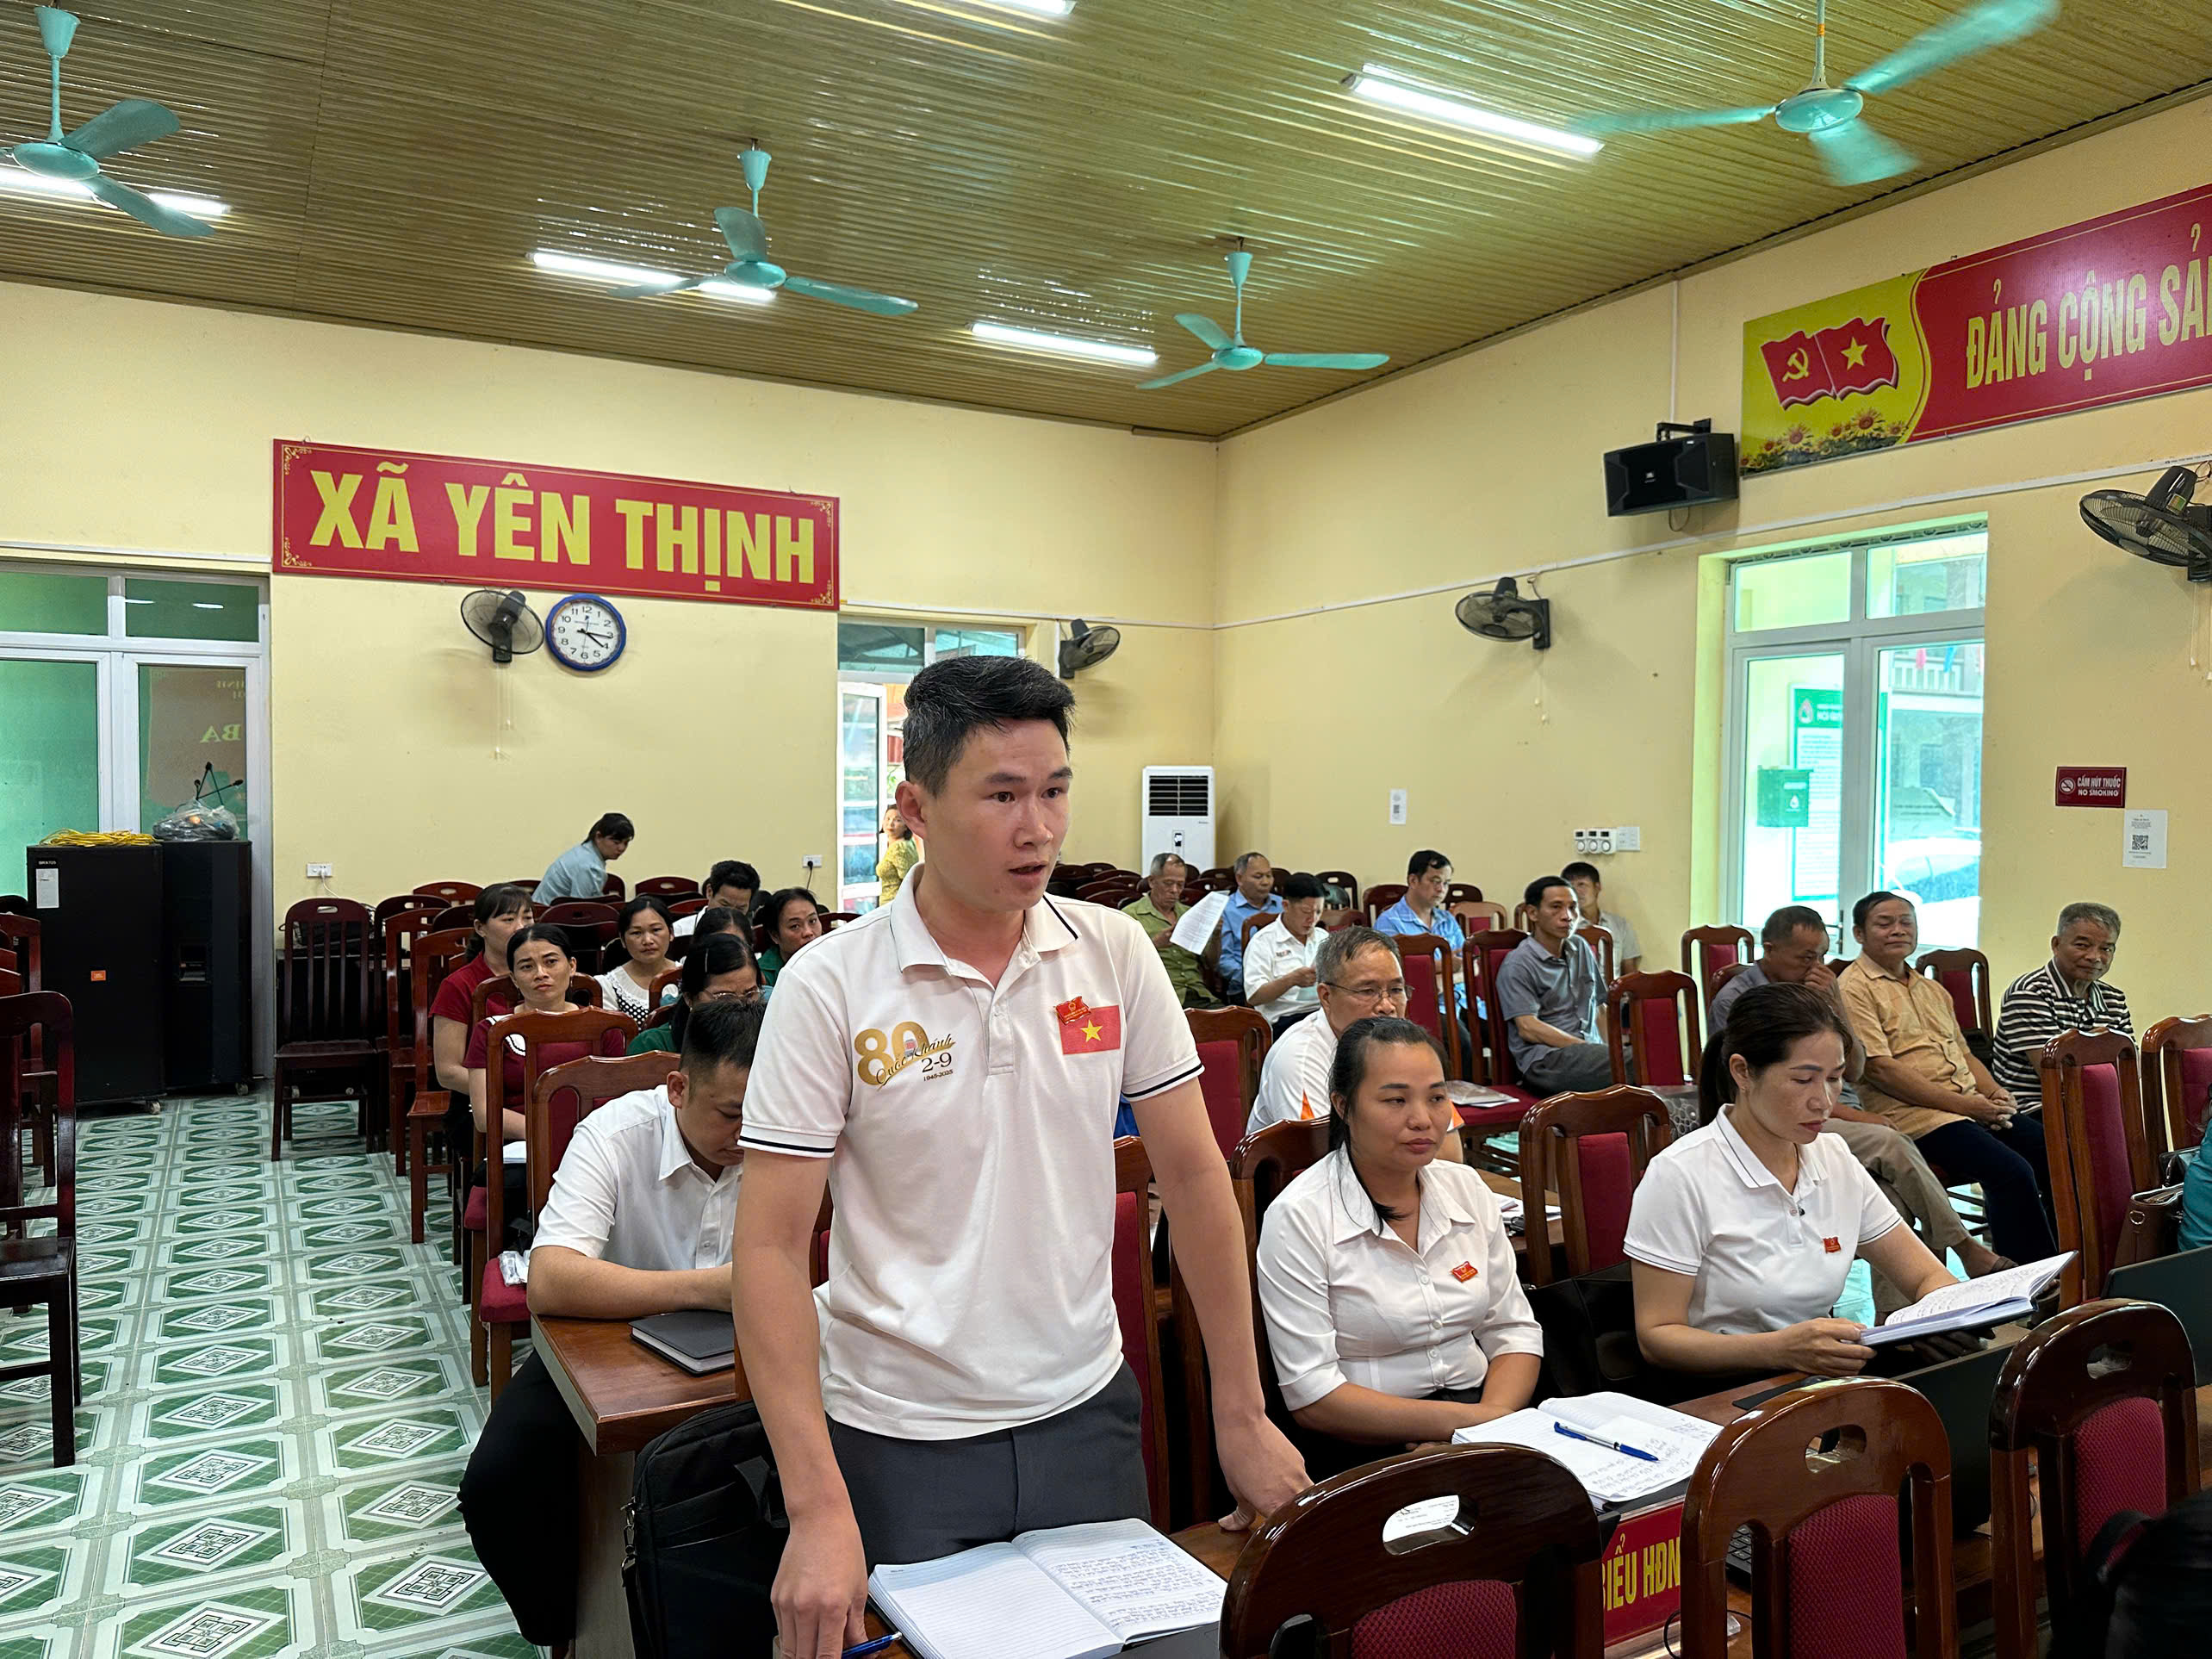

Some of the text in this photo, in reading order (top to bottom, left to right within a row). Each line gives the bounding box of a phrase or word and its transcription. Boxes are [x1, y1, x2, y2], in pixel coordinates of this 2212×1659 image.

[1967, 223, 2212, 389] ĐẢNG CỘNG SẢ
[309, 461, 815, 592] XÃ YÊN THỊNH
[2091, 775, 2102, 787] HÚT
[2103, 774, 2122, 788] THUỐC
[854, 1022, 930, 1086] 80
[921, 1052, 953, 1073] 2-9
[1602, 1533, 1637, 1612] IỂU
